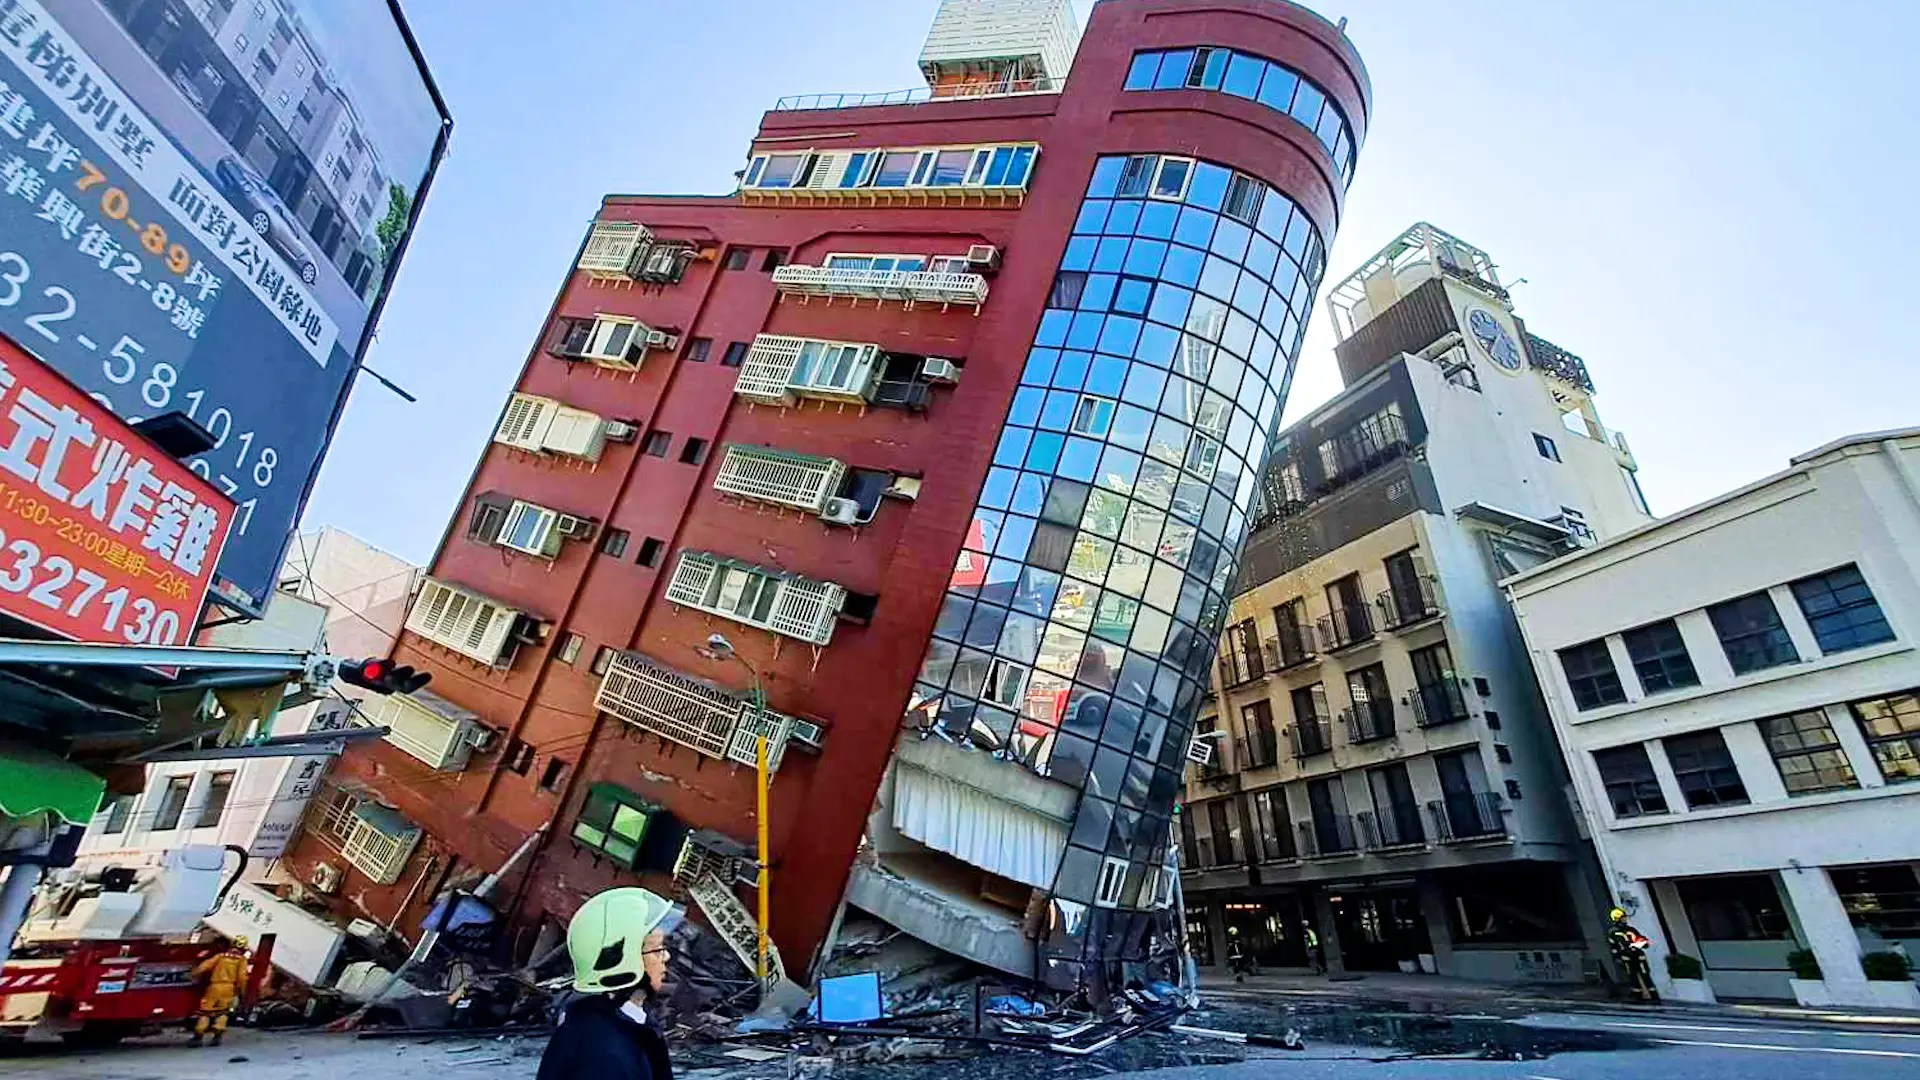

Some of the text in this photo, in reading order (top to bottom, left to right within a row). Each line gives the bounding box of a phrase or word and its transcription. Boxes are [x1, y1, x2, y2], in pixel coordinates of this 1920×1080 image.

[168, 175, 323, 347] 面對公園綠地
[0, 360, 218, 577] 式炸雞
[0, 528, 179, 646] 327130
